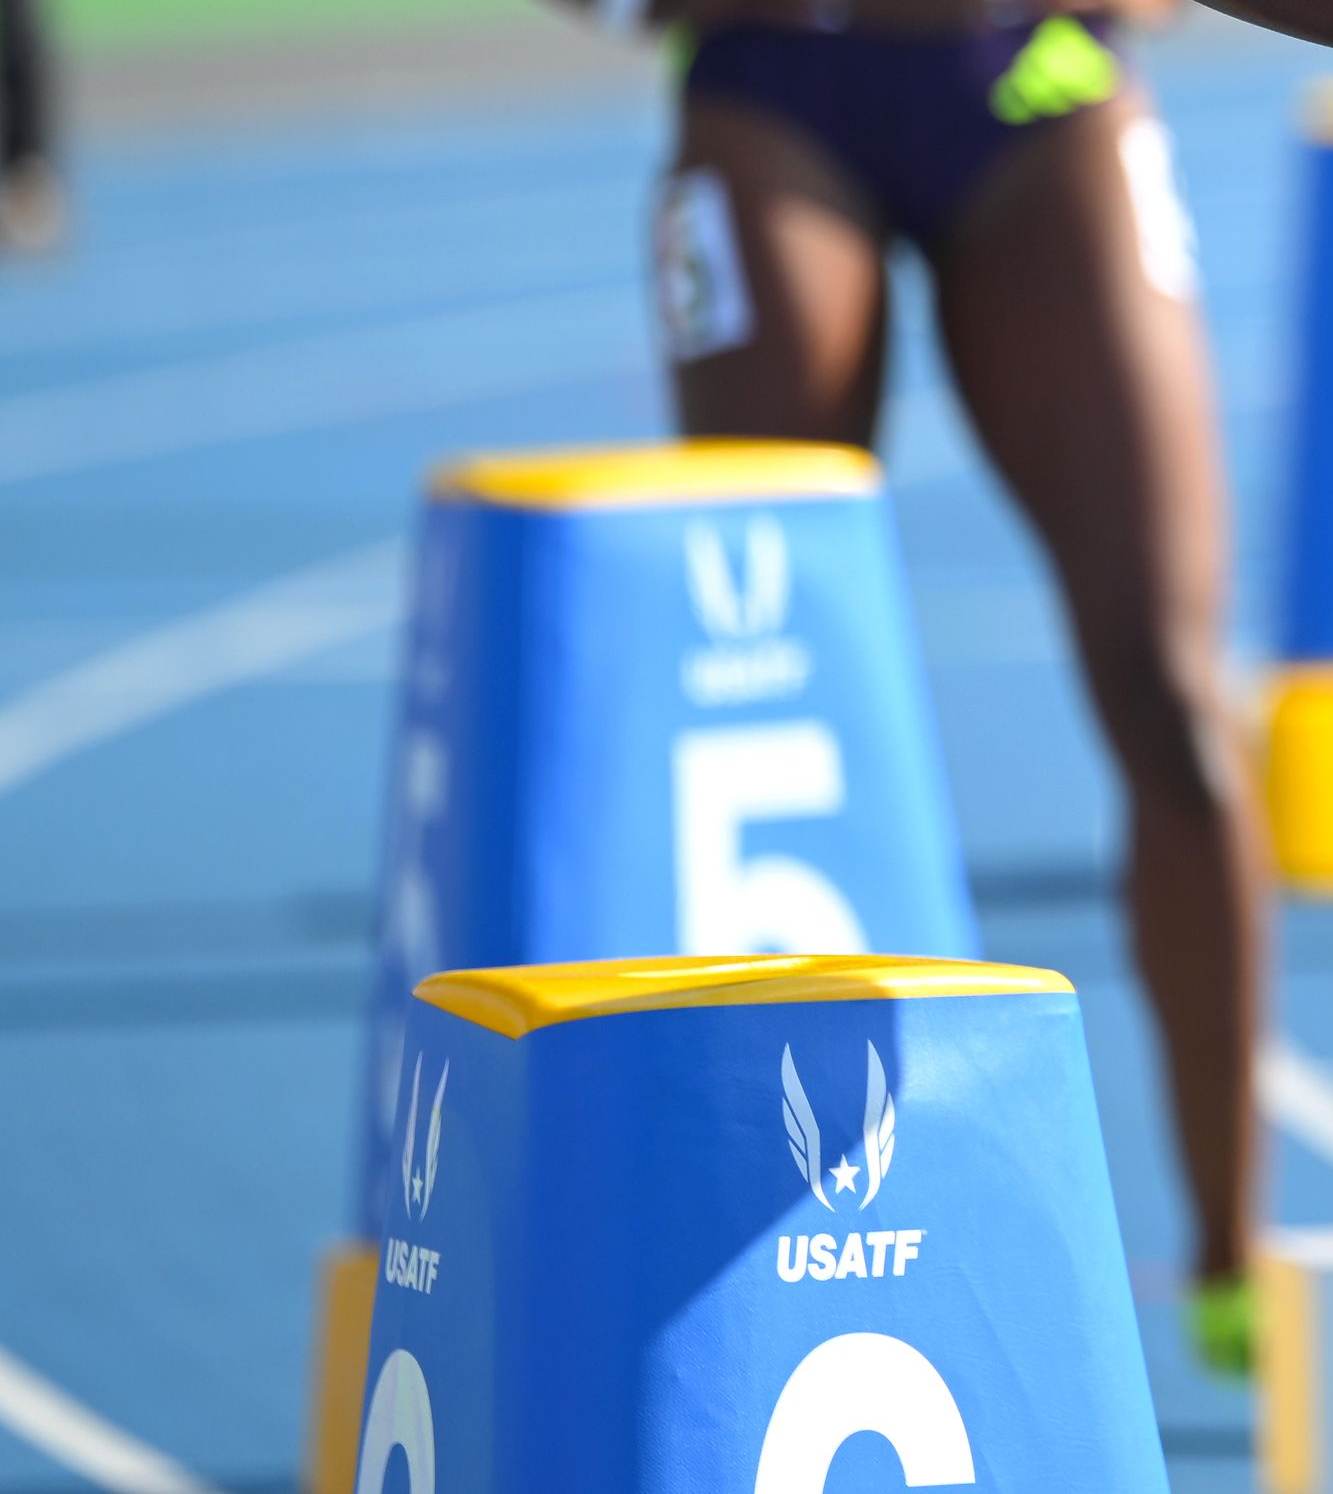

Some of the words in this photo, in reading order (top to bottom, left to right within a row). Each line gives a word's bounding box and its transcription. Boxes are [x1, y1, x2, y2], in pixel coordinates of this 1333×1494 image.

[673, 721, 870, 955] 5
[386, 1237, 440, 1294] USATF
[777, 1229, 922, 1283] USATF
